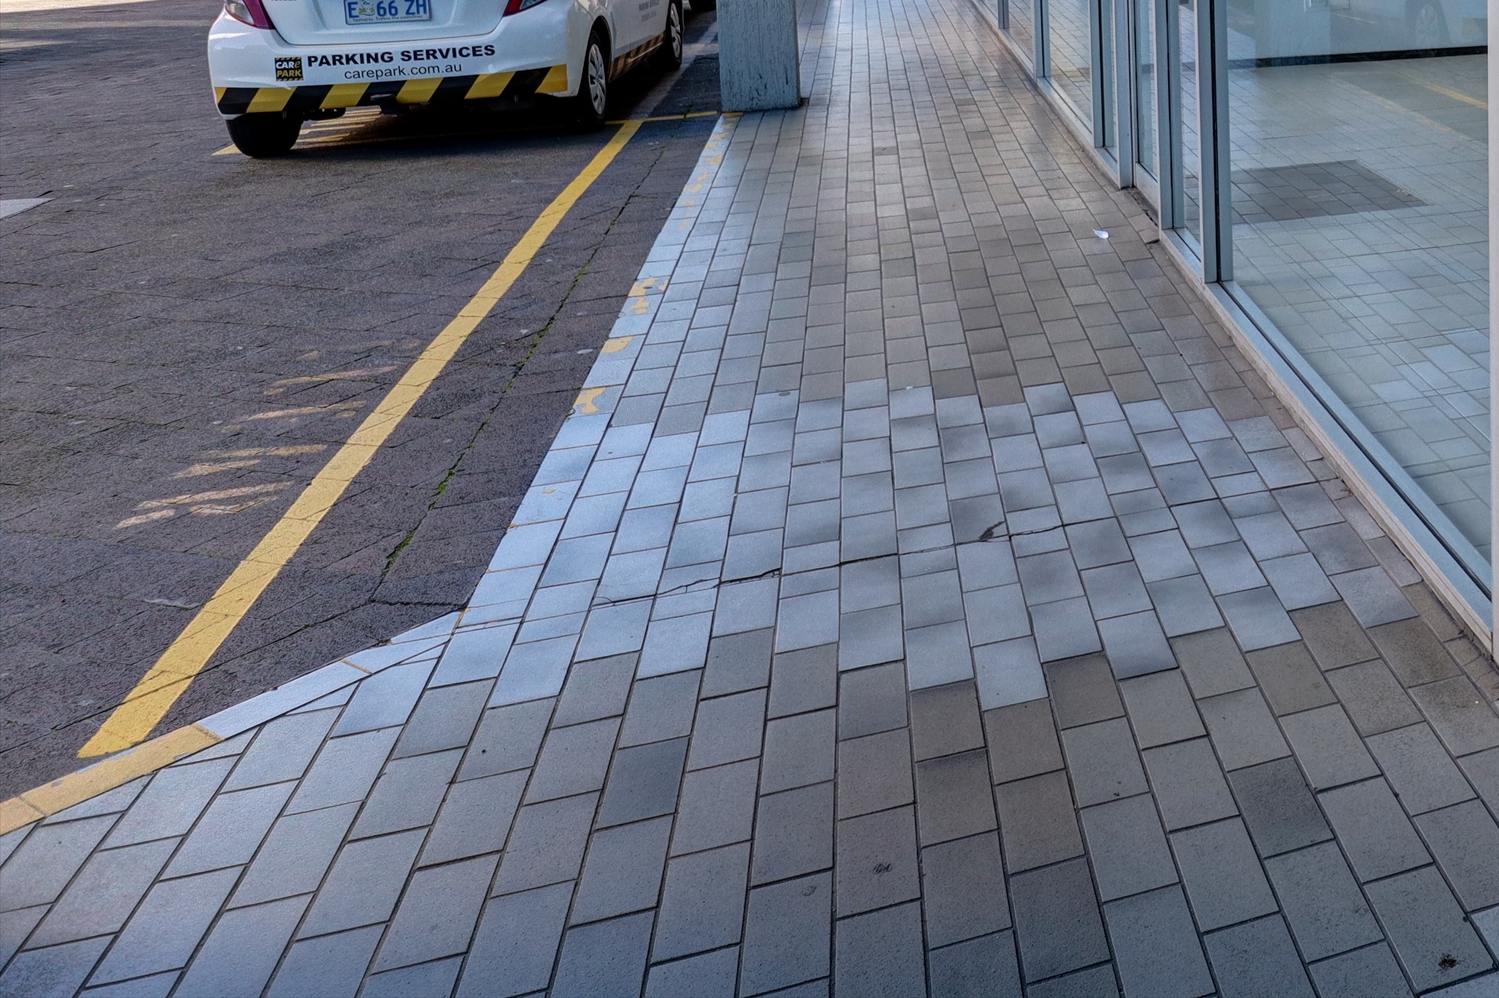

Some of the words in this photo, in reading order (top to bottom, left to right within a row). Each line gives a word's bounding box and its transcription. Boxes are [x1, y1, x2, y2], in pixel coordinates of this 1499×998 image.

[348, 2, 358, 18] E
[376, 1, 399, 17] 66
[307, 52, 394, 67] PARKING
[400, 44, 496, 62] SERVICES
[276, 68, 302, 78] PARK
[344, 62, 463, 80] carepark.com.au
